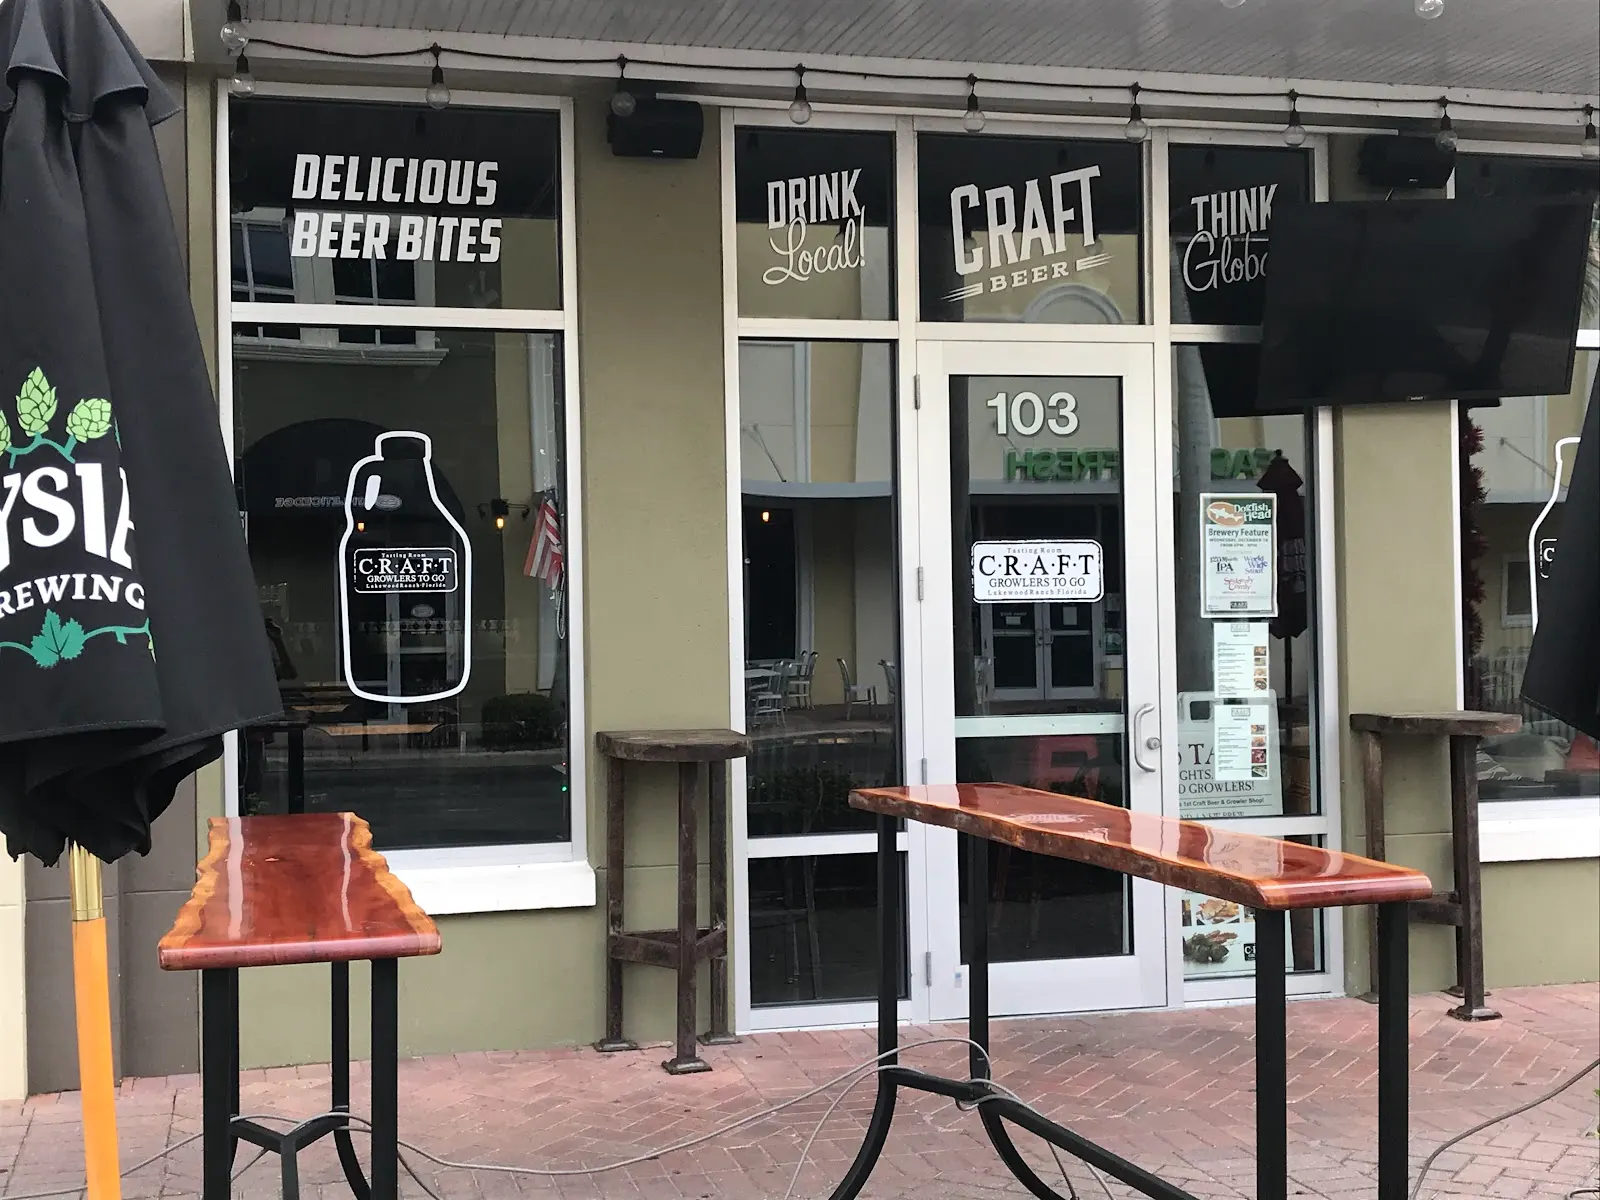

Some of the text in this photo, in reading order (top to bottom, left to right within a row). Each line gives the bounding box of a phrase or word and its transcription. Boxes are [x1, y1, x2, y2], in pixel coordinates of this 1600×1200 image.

[291, 153, 499, 206] DELICIOUS
[767, 168, 863, 230] DRINK
[1190, 183, 1279, 239] THINK
[290, 211, 503, 263] BEER BITES
[950, 164, 1101, 277] CRAFT
[762, 205, 867, 286] Local!
[989, 260, 1070, 294] BEER
[986, 390, 1080, 437] 103
[1234, 503, 1268, 513] Dogfish
[1244, 509, 1271, 521] Head
[1208, 528, 1269, 538] Brewery Feature
[367, 574, 445, 583] GROWLERS TO GO
[989, 576, 1086, 588] GROWLERS TO GO
[1216, 562, 1234, 572] IPA
[1188, 780, 1255, 794] GROWLERS!
